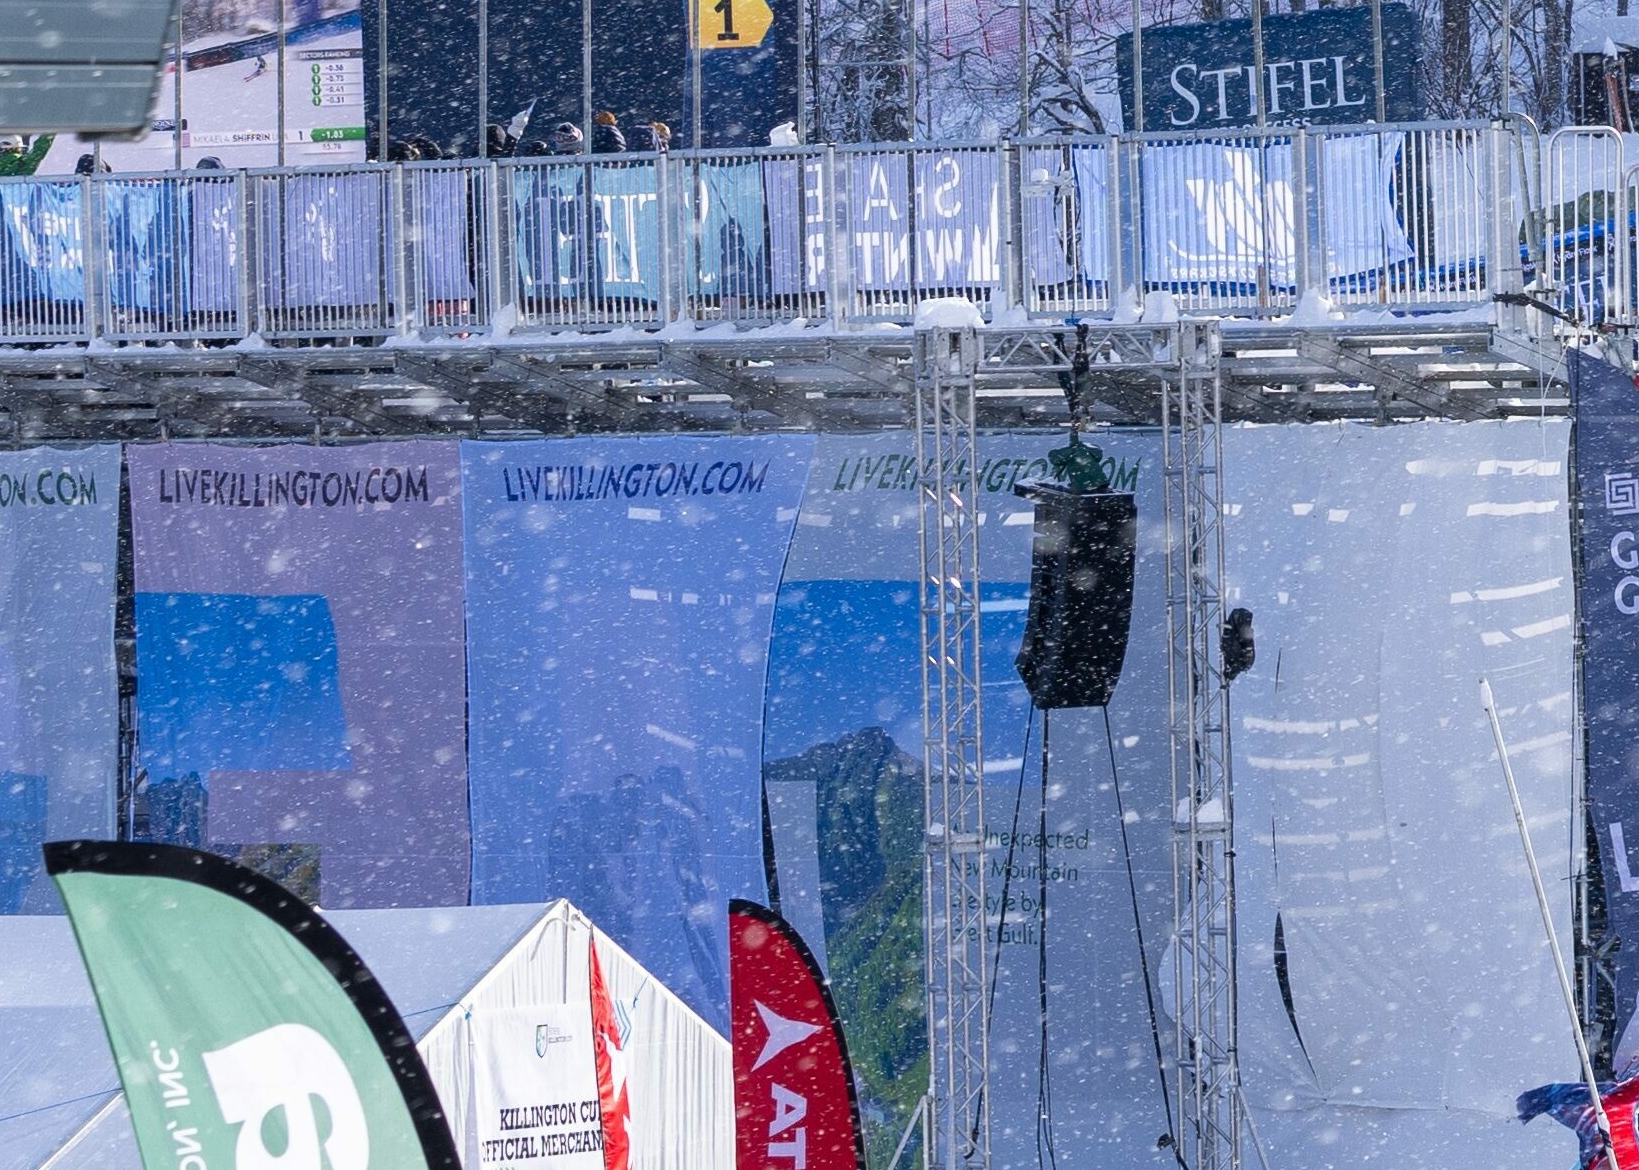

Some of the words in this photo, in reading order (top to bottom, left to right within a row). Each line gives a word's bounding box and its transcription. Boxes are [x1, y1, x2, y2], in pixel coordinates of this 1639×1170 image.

[1170, 55, 1367, 127] STIFEL
[232, 133, 271, 143] SHIFFRIN
[159, 465, 429, 509] LIVEKILLINGTON.COM
[502, 460, 771, 505] LIVEKILLINGTON.COM
[499, 1101, 578, 1132] KILLINGTON
